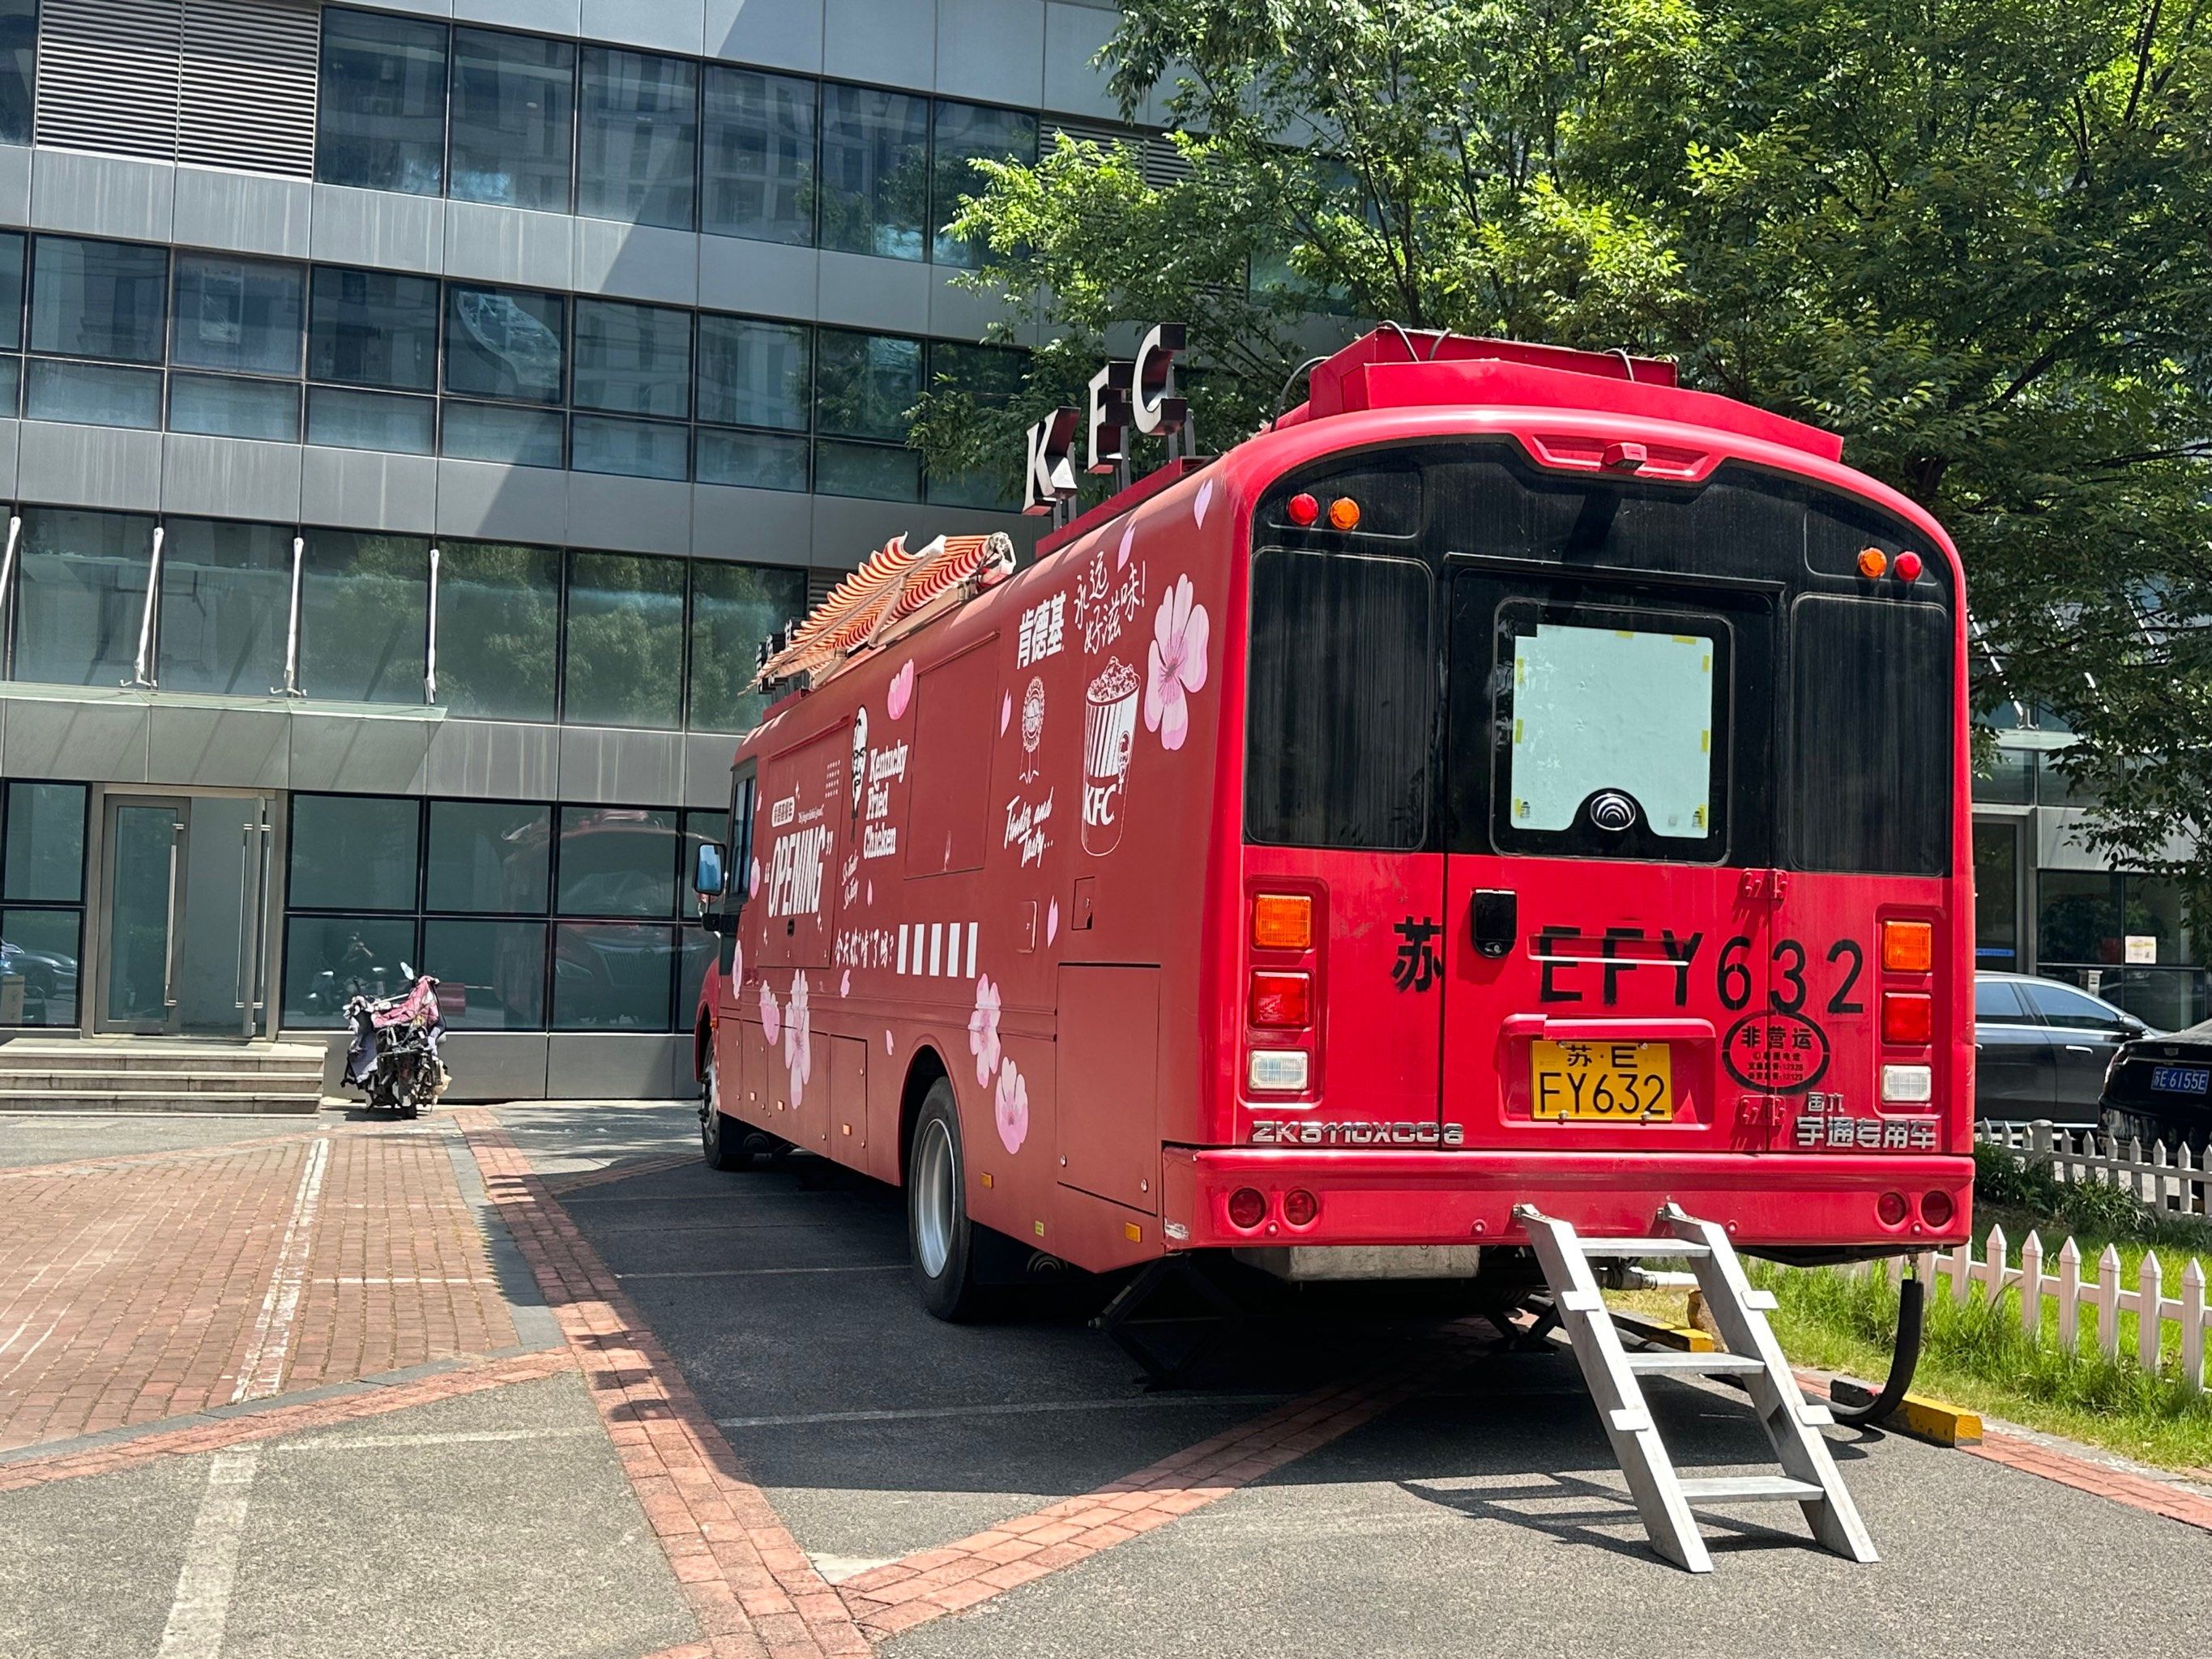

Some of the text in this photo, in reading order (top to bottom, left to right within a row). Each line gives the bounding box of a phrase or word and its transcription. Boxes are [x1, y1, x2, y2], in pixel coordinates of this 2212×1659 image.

[1023, 322, 1187, 516] KFC
[1074, 551, 1109, 629] 永远
[1017, 591, 1066, 670] 肯德基
[869, 739, 908, 791] Kentucky
[866, 782, 889, 821] Fried
[1083, 782, 1117, 826] KFC
[863, 821, 897, 859] Chicken
[1392, 915, 1443, 993] 苏
[1741, 1026, 1813, 1050] 非营运
[1539, 1072, 1665, 1115] FY632
[1807, 1092, 1844, 1112] 国六
[1796, 1115, 1937, 1149] 宇通专用车
